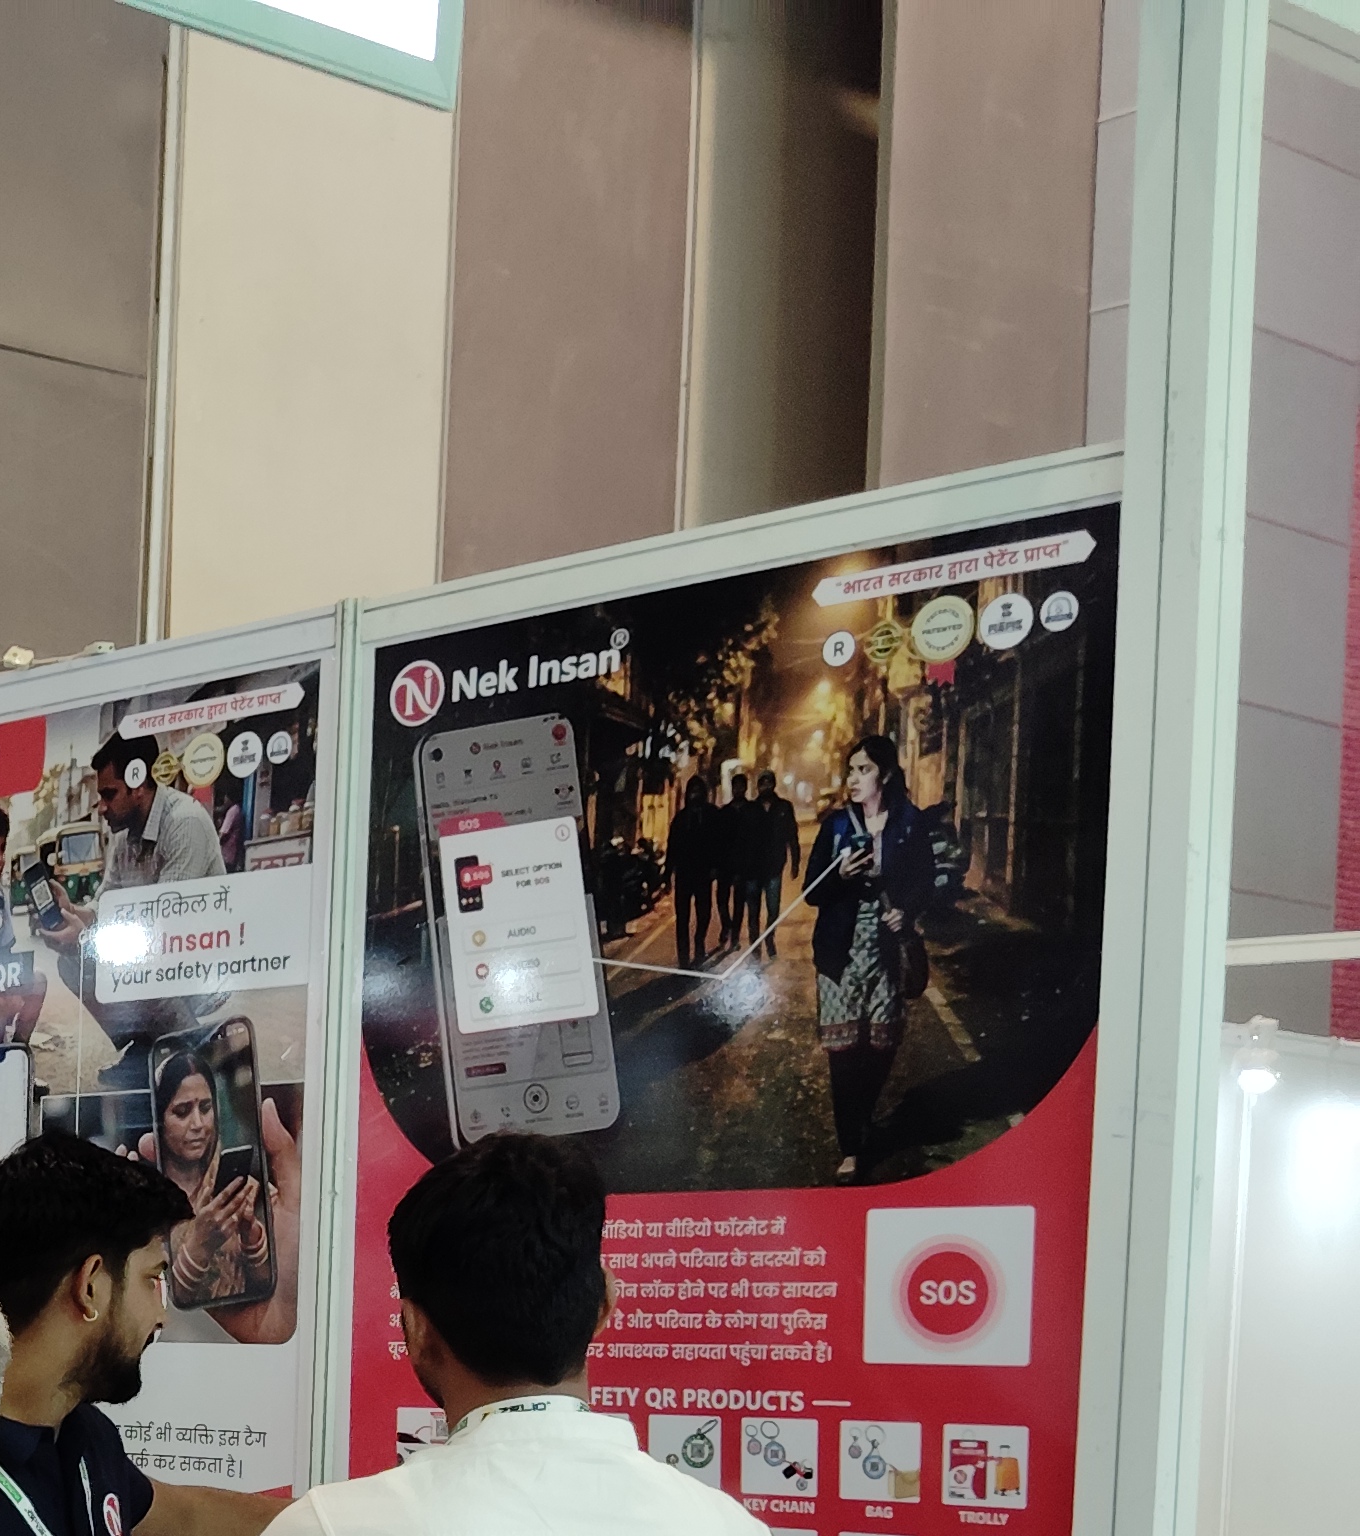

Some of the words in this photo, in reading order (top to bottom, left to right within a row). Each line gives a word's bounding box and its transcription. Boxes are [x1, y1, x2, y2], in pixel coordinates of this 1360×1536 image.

[888, 564, 943, 587] सरकार
[948, 558, 979, 580] द्वारा
[983, 549, 1020, 570] पेटेंट
[450, 653, 519, 703] Nek
[458, 818, 480, 831] SOS
[501, 866, 529, 878] SELECT
[532, 861, 563, 874] OPTION
[161, 929, 231, 955] Insan
[508, 926, 537, 939] AUDIO
[111, 969, 152, 993] your
[155, 961, 213, 983] safety
[217, 955, 291, 980] partner
[646, 1221, 663, 1238] या
[665, 1217, 711, 1238] वीडियो
[770, 1216, 787, 1236] में
[608, 1252, 639, 1268] साथ
[641, 1249, 677, 1268] अपने
[680, 1247, 728, 1268] परिवार
[730, 1248, 747, 1267] के
[803, 1246, 827, 1267] को
[640, 1279, 675, 1298] लॉक
[678, 1279, 705, 1300] होने
[708, 1282, 728, 1298] पर
[730, 1278, 749, 1298] भी
[752, 1282, 780, 1298] एक
[782, 1281, 838, 1298] सायरन
[919, 1279, 977, 1307] SOS
[655, 1309, 703, 1329] परिवार
[705, 1309, 722, 1329] के
[724, 1310, 758, 1329] लोग
[760, 1313, 778, 1329] या
[781, 1308, 828, 1335] पुलिस
[607, 1343, 669, 1359] आवश्यक
[671, 1343, 727, 1360] सहायता
[770, 1341, 813, 1361] सकते
[645, 1390, 677, 1410] QR
[683, 1390, 806, 1412] PRODUCTS
[124, 1421, 154, 1443] कोई
[156, 1422, 172, 1443] भी
[218, 1429, 241, 1446] इस
[243, 1425, 267, 1447] टैग
[153, 1454, 176, 1470] कर
[178, 1455, 223, 1473] सकता
[770, 1500, 816, 1515] CHAIN
[865, 1505, 894, 1519] BAG
[958, 1510, 1010, 1526] TROLLY
